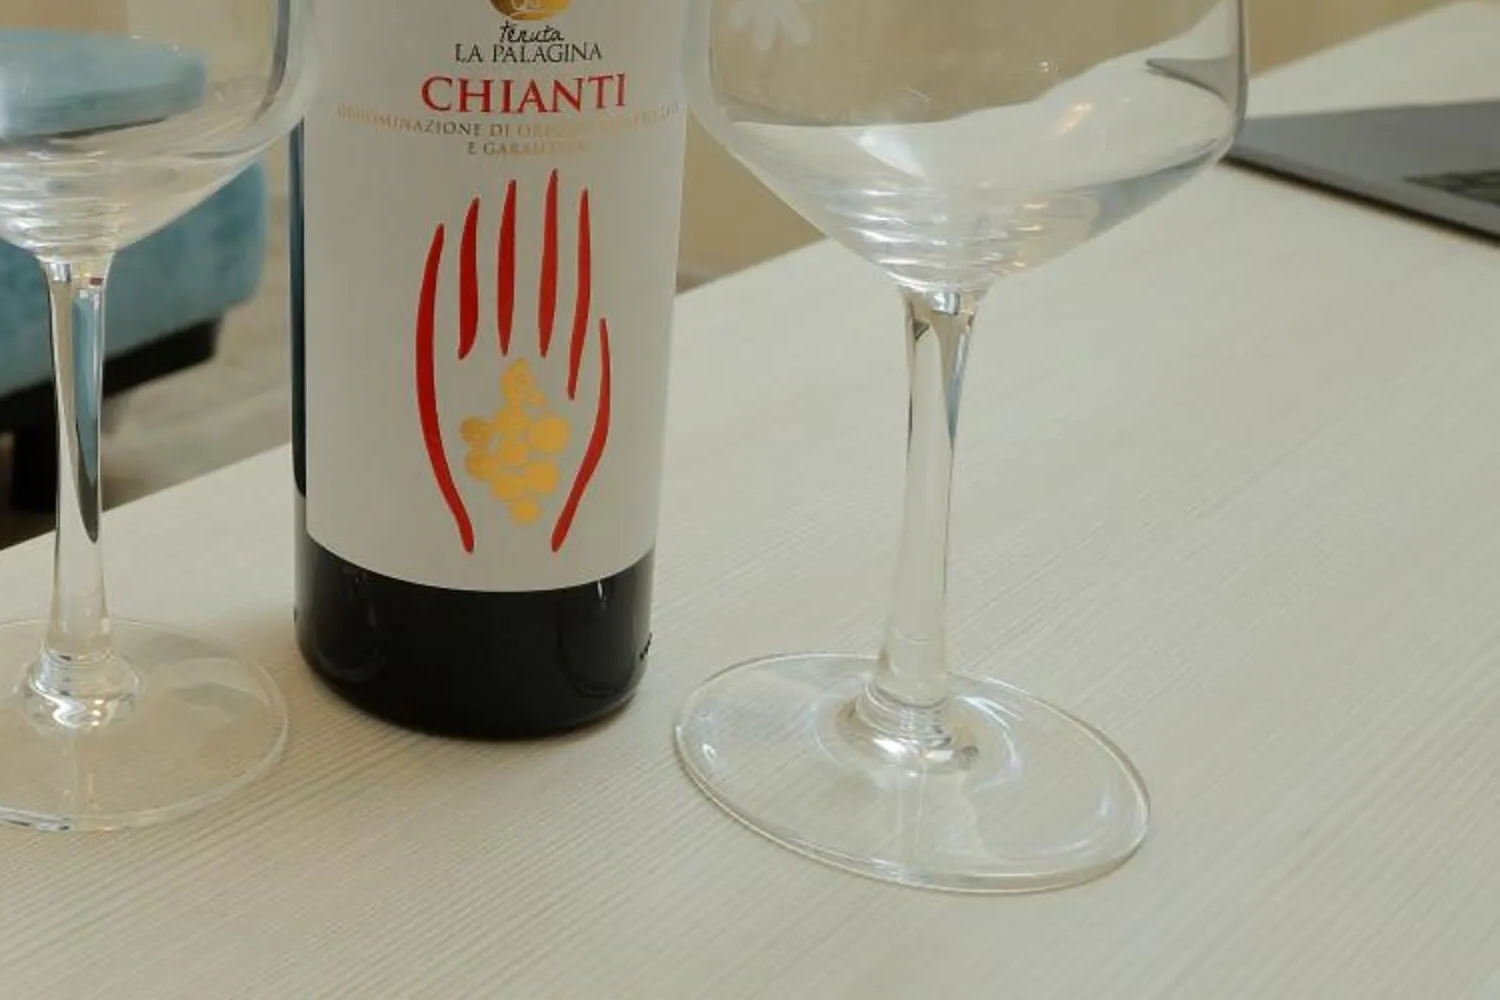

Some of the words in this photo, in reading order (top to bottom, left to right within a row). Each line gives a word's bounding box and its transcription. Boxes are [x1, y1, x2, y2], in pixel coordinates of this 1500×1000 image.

[500, 20, 565, 43] tenuta
[455, 43, 483, 63] LA
[492, 41, 603, 64] PALAGINA
[421, 72, 626, 114] CHIANTI
